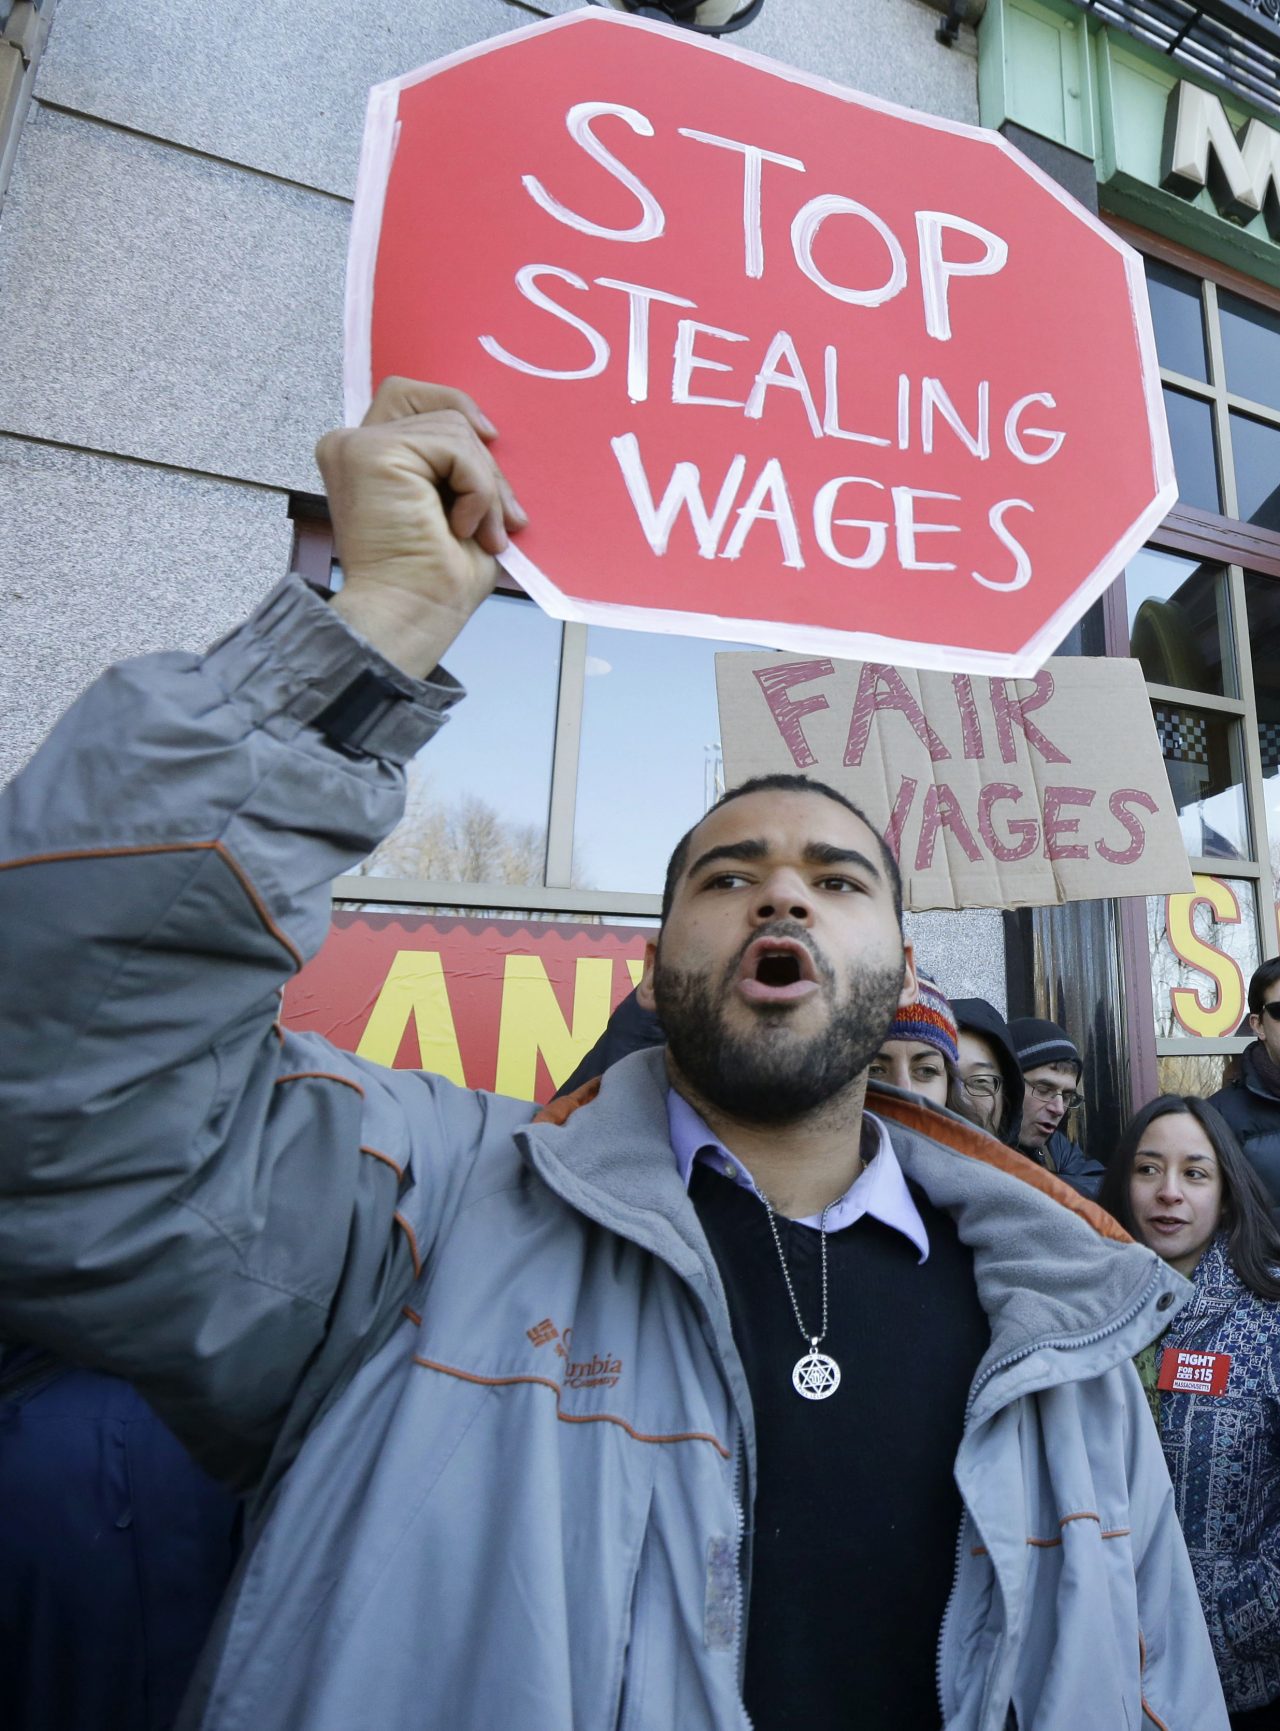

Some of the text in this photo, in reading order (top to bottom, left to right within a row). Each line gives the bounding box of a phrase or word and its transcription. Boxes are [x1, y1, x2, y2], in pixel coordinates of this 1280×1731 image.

[520, 100, 1008, 341] STOP
[478, 263, 1066, 465] STEALING
[610, 431, 1036, 592] WAGES
[752, 658, 1072, 769] FAIR
[355, 949, 645, 1102] AN
[1173, 1380, 1211, 1392] MASSACHUSETTS
[1177, 1353, 1216, 1367] FIGHT
[1177, 1366, 1214, 1382] FOR $15
